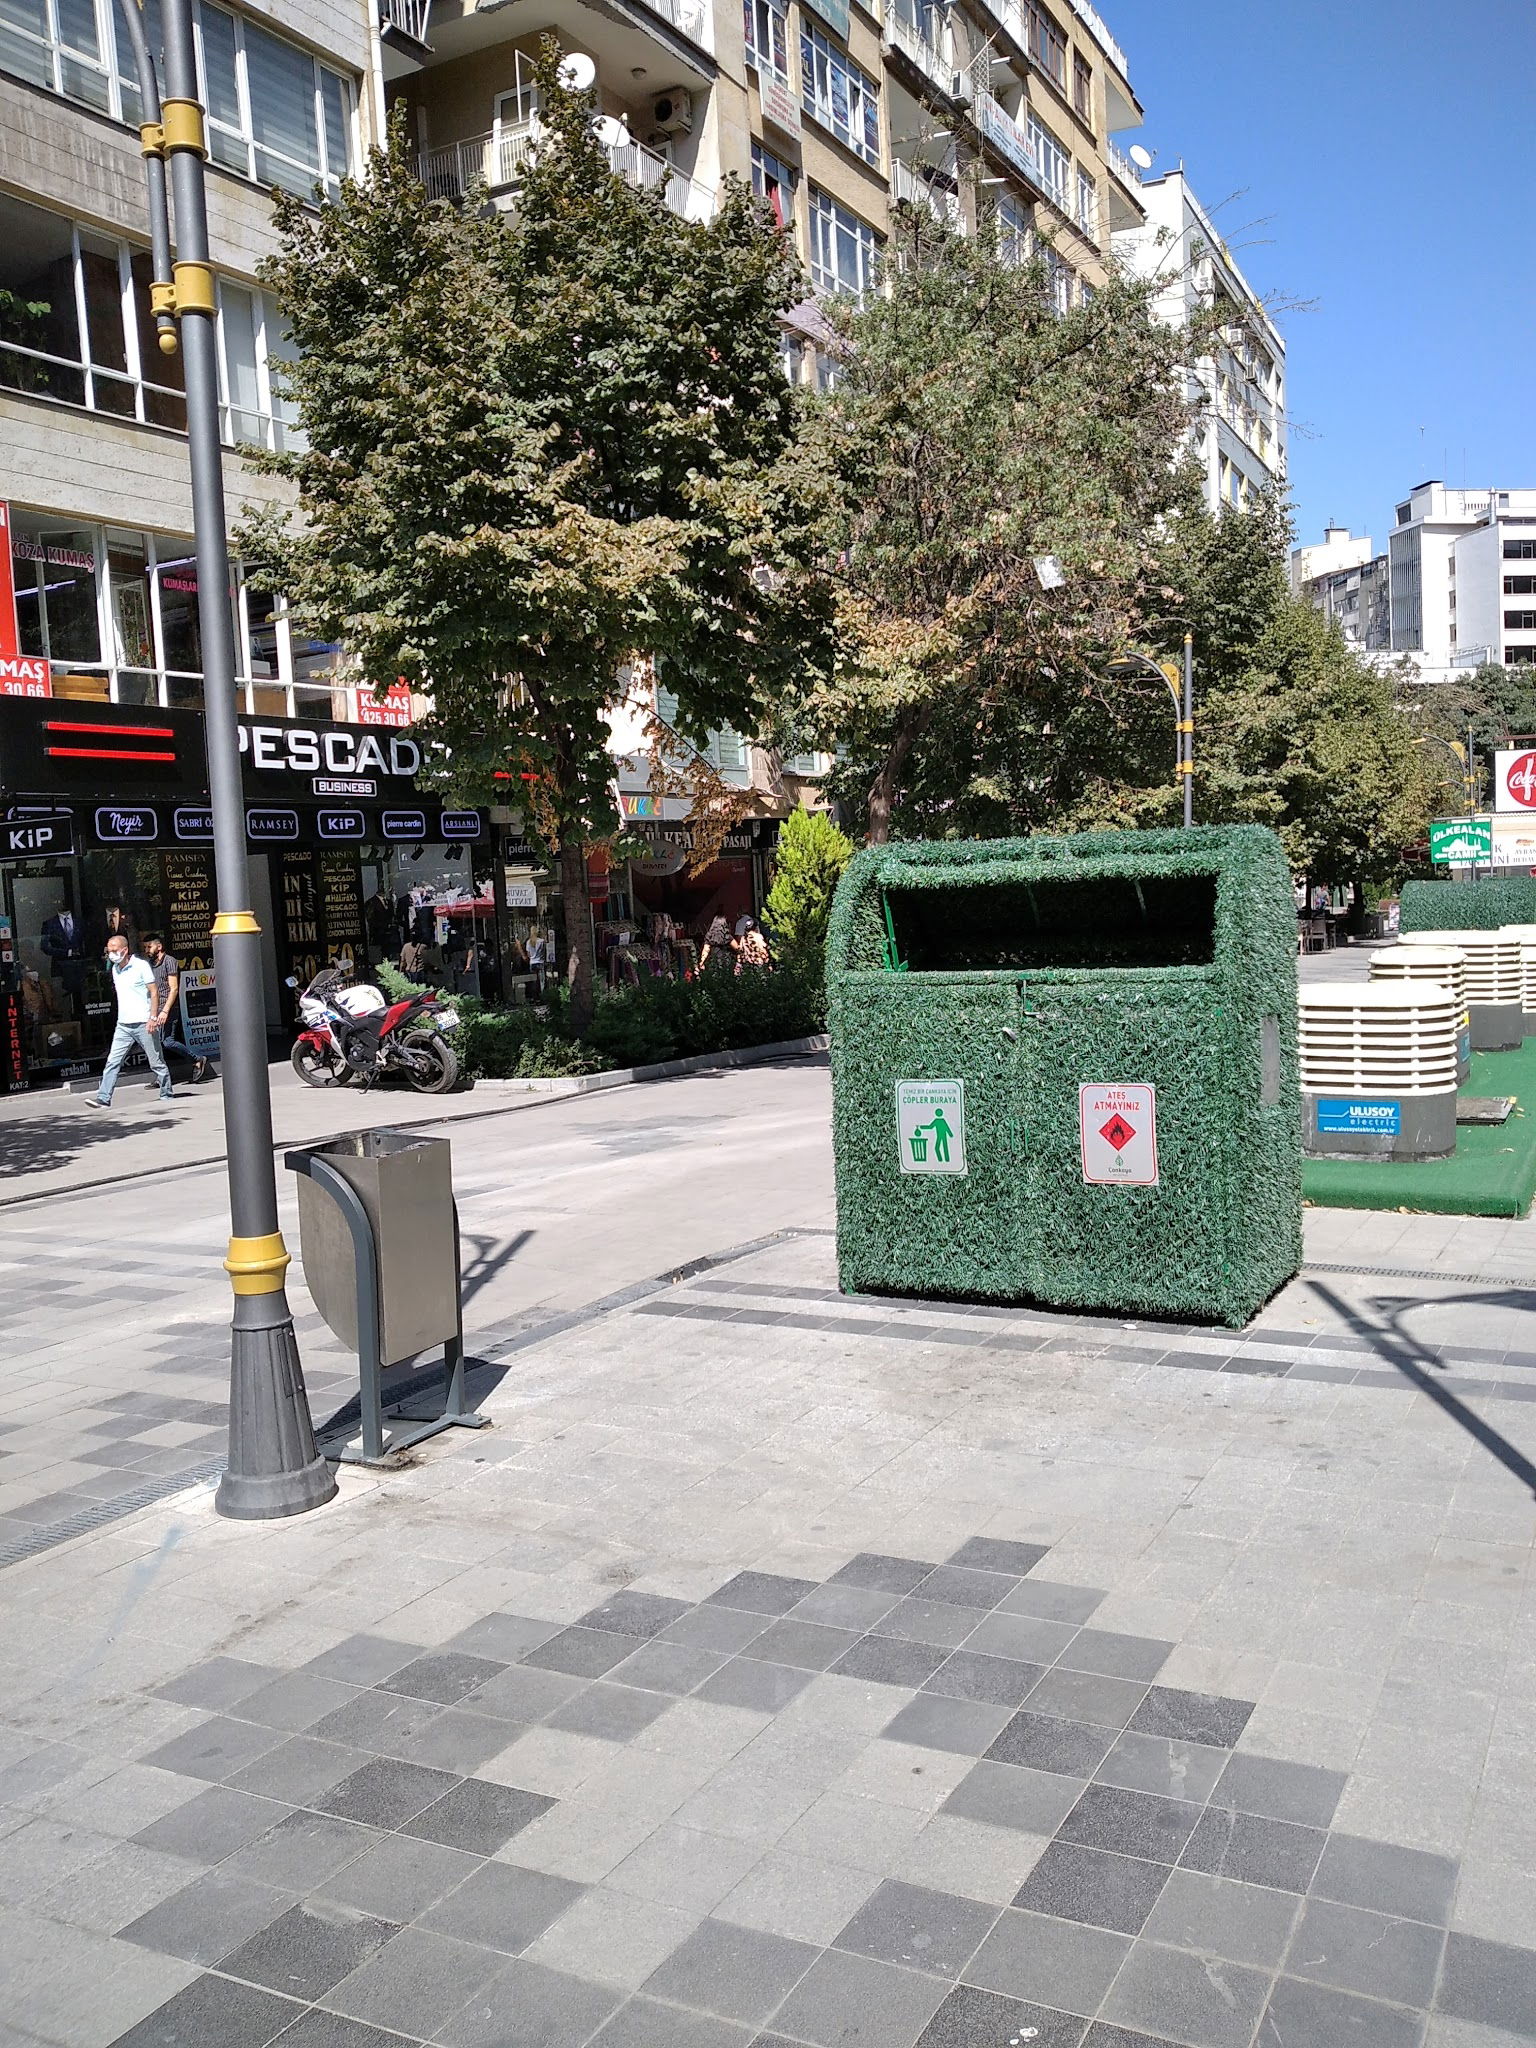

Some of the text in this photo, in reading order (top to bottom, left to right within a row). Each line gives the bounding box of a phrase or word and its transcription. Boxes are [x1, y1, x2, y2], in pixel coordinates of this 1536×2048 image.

[11, 541, 95, 573] KOZA KUMAŞ
[364, 711, 409, 728] 425 30 66
[237, 725, 452, 776] ESCAD
[319, 781, 372, 793] BUSINESS
[179, 817, 203, 828] SABRİ
[251, 819, 294, 829] RAMSEY
[387, 819, 421, 828] pierre cardin
[165, 854, 207, 863] RAMSEY
[283, 852, 312, 861] PESCADO
[320, 851, 355, 859] RAMSEY
[323, 875, 356, 883] PESCADO
[169, 881, 208, 889] PESCADO
[178, 889, 201, 900] KİP
[326, 903, 358, 911] PESCADO
[171, 913, 211, 921] PESCADO
[191, 1027, 204, 1036] PTT
[930, 1096, 957, 1104] BURAYA
[1107, 1091, 1126, 1101] ATEŞ
[1094, 1101, 1140, 1111] ATMAYINIZ
[1349, 1106, 1395, 1117] ULUSOY
[1350, 1118, 1396, 1127] electric
